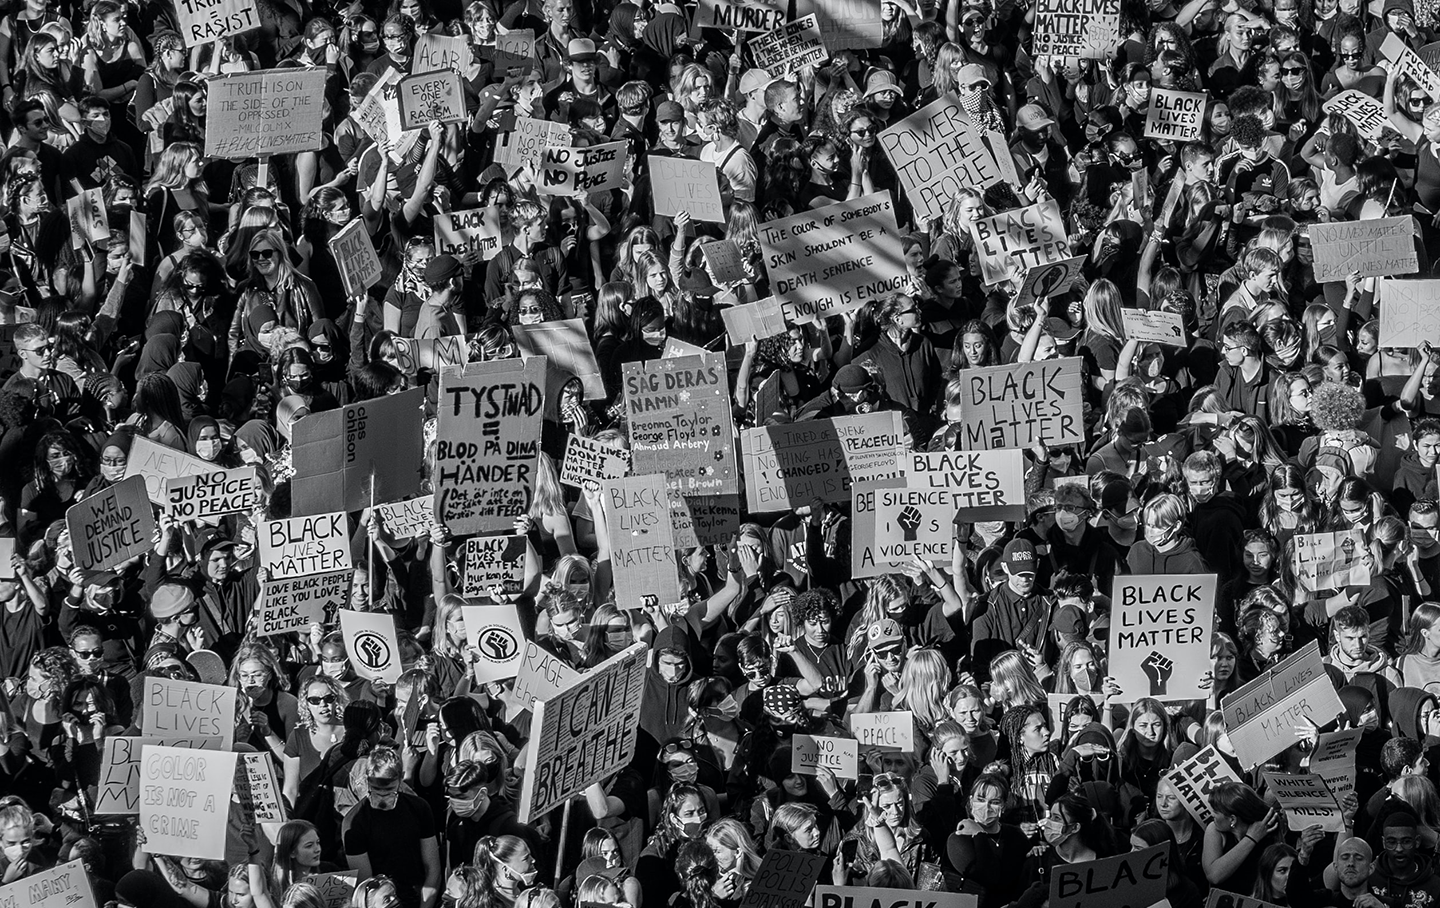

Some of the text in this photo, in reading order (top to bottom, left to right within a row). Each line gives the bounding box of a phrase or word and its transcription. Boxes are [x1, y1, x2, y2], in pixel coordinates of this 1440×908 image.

[191, 8, 254, 41] RASIST
[714, 7, 784, 30] MURDER
[1036, 15, 1089, 34] MATTER
[1034, 45, 1080, 55] NO PEACE
[1035, 34, 1082, 44] NO JUSTICE
[420, 43, 460, 69] ACAB
[1405, 51, 1430, 80] FUCK
[273, 82, 283, 91] IS
[286, 81, 303, 91] ON
[1405, 61, 1434, 91] TRUMP
[221, 96, 312, 111] THE SIDE OF THE
[420, 90, 441, 101] ONE
[1155, 95, 1202, 113] BLACK
[410, 106, 452, 120] RACISM
[1159, 111, 1196, 124] LIVES
[882, 105, 969, 156] POWER
[547, 148, 616, 168] NO JUSTICE
[898, 155, 933, 189] TO
[929, 130, 970, 169] THE
[544, 170, 607, 189] NO PEACE
[761, 201, 890, 244] THE COLOR OF SOMEBODY'S
[770, 251, 797, 269] SKIN
[859, 230, 874, 241] BE
[879, 227, 887, 236] A
[777, 255, 873, 295] DEATH SENTENCE
[781, 297, 834, 323] ENOUGH
[840, 291, 852, 305] IS
[664, 367, 719, 390] DERAS
[971, 366, 1065, 405] BLACK
[630, 394, 679, 414] NAMN
[992, 400, 1062, 424] LIVES
[357, 407, 366, 440] clas
[631, 412, 712, 431] Breonna Taylor
[347, 409, 355, 462] ohlson
[632, 428, 695, 444] George Floyd
[438, 435, 537, 462] BLOD PÅ DINA
[196, 472, 227, 486] NO
[441, 460, 529, 486] HÄNDER
[170, 478, 252, 503] JUSTICE
[882, 491, 948, 506] SILENCE
[91, 494, 116, 518] WE
[172, 491, 252, 517] NO PEACE
[85, 506, 132, 540] DEMAND
[270, 515, 344, 547] BLACK
[81, 525, 144, 570] JUSTICE
[281, 538, 324, 557] LIVES
[879, 543, 948, 556] VIOLENCE
[1122, 588, 1202, 606] BLACK
[1122, 608, 1195, 627] LIVES
[1118, 627, 1203, 649] MATTER
[554, 698, 564, 751] I
[875, 715, 890, 724] NO
[817, 740, 834, 752] NO
[863, 727, 897, 745] PEACE
[146, 754, 206, 781] COLOR
[535, 713, 634, 811] BREATHE
[801, 754, 841, 765] JUSTICE
[145, 786, 164, 804] IS
[168, 788, 198, 807] NOT
[149, 815, 198, 838] CRIME
